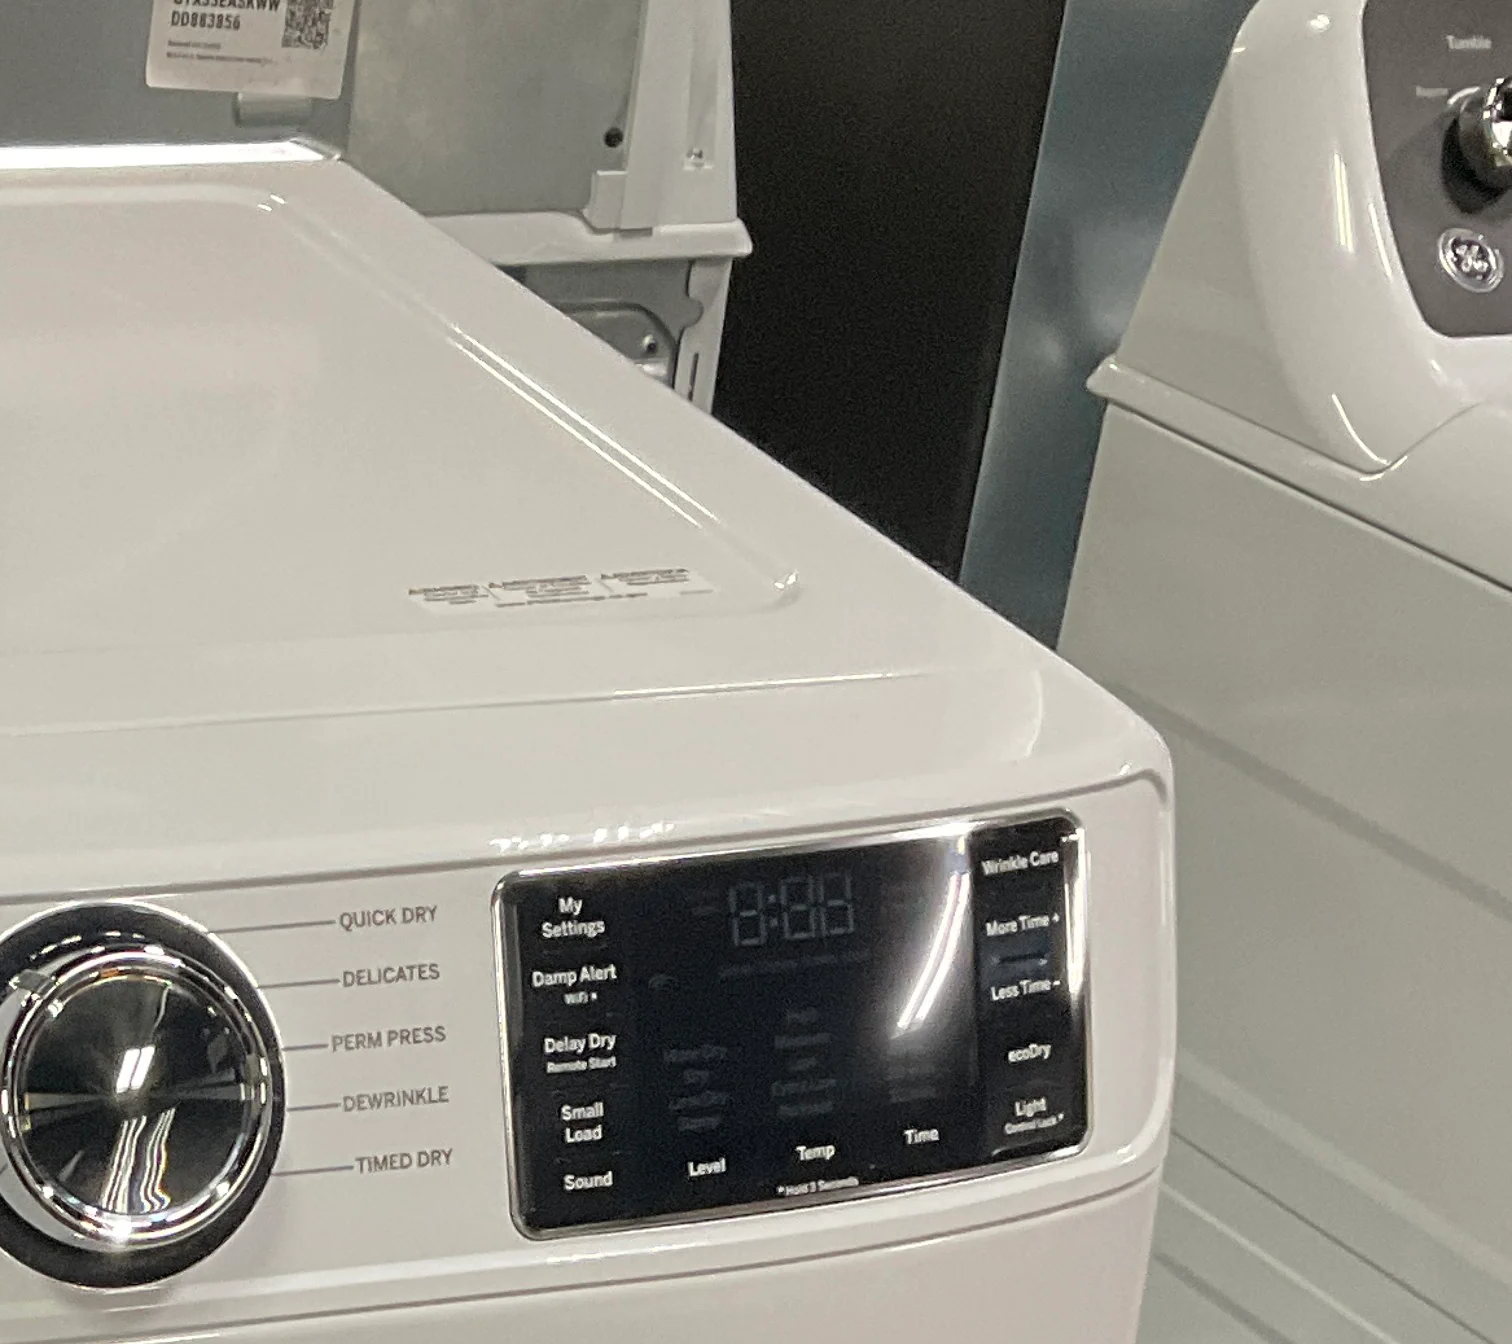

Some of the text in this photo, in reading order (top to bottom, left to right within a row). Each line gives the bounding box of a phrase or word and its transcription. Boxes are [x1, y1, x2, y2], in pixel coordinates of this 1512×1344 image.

[981, 850, 1060, 876] Wrinkle Care
[558, 896, 583, 915] My
[339, 905, 438, 932] QUICK DRY
[541, 920, 606, 939] Settings
[985, 918, 1018, 936] More
[1019, 914, 1050, 930] Time
[342, 963, 441, 988] DELICATES
[532, 964, 617, 988] Damp Alert
[991, 985, 1019, 1001] Less
[1019, 978, 1050, 995] Time
[331, 1025, 446, 1052] PERM PRESS
[544, 1032, 617, 1054] Delay Dry
[342, 1085, 449, 1112] DEWRINKLE
[1015, 1096, 1047, 1118] Light
[561, 1101, 604, 1121] Small
[565, 1125, 603, 1143] Load
[904, 1127, 940, 1145] Time
[355, 1148, 453, 1174] TIMED DRY
[796, 1144, 835, 1161] Temp
[688, 1157, 727, 1177] Level
[563, 1171, 613, 1191] Sound
